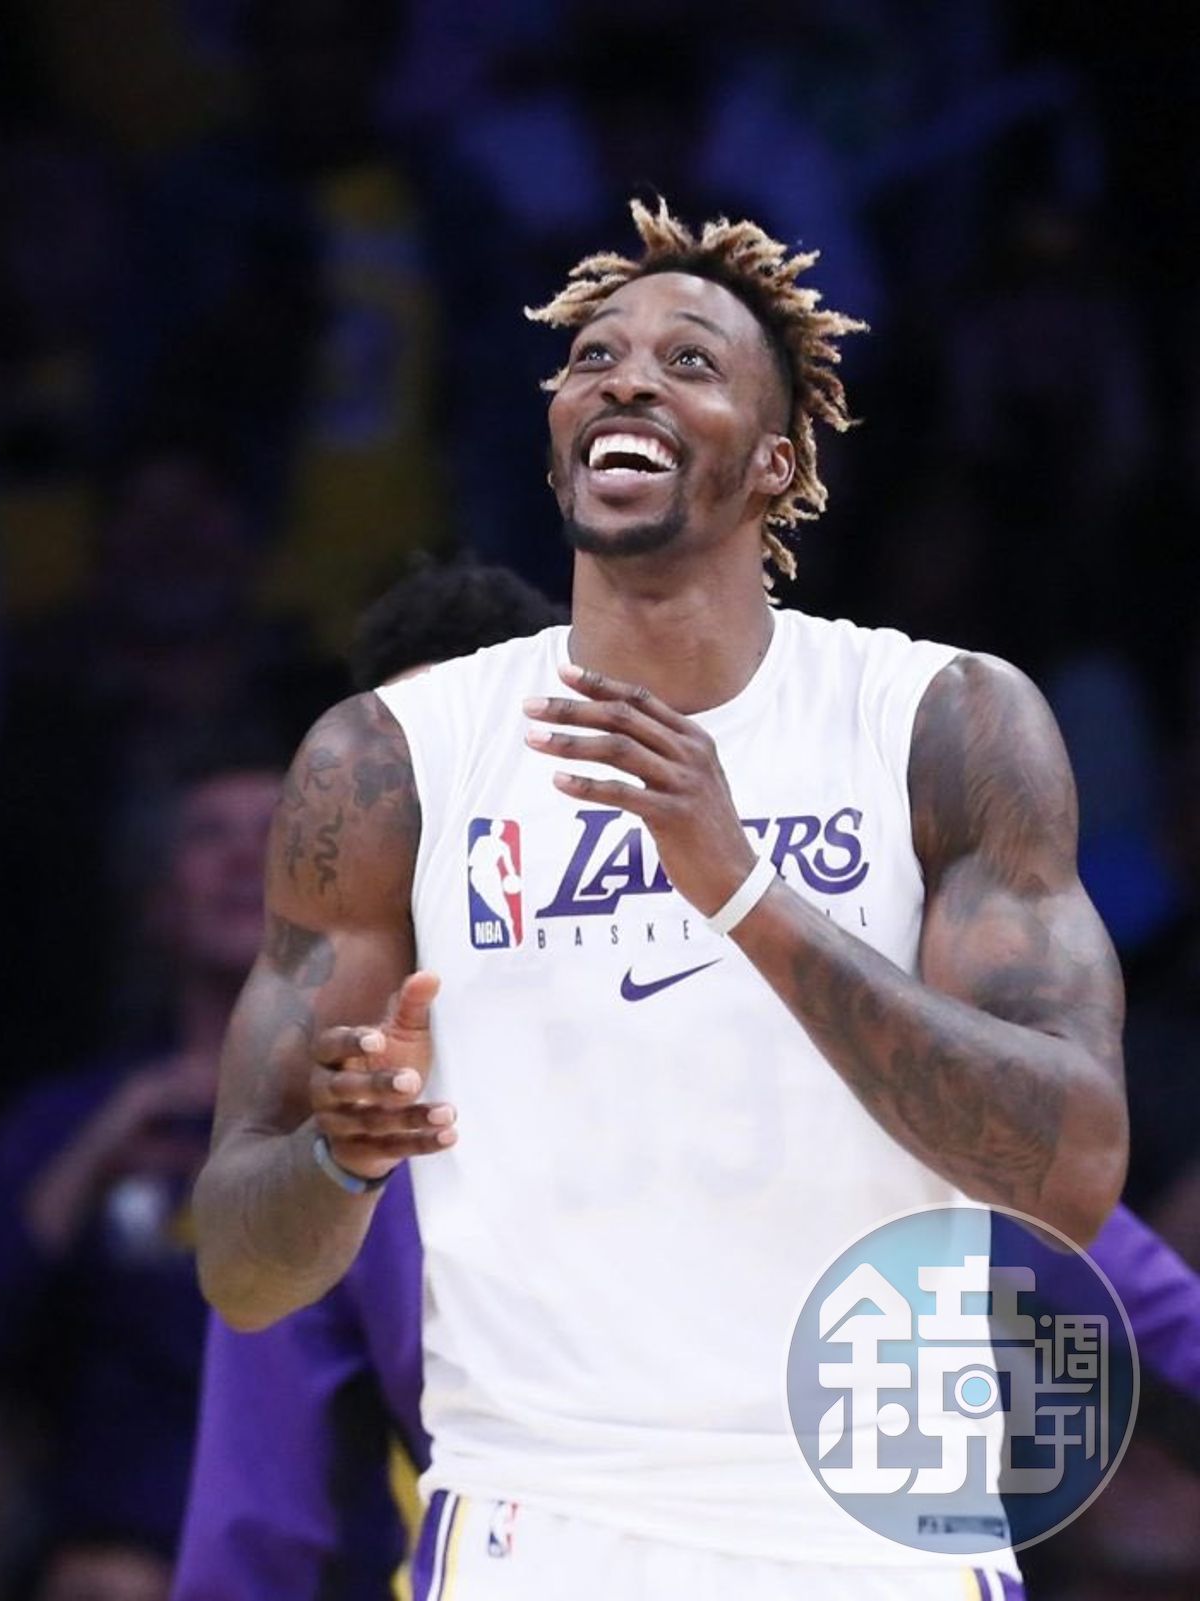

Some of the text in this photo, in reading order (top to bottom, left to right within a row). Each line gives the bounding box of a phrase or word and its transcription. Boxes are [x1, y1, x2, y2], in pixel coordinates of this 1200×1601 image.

[534, 807, 870, 919] LARS
[474, 920, 504, 944] NBA
[538, 906, 867, 949] BASKEL
